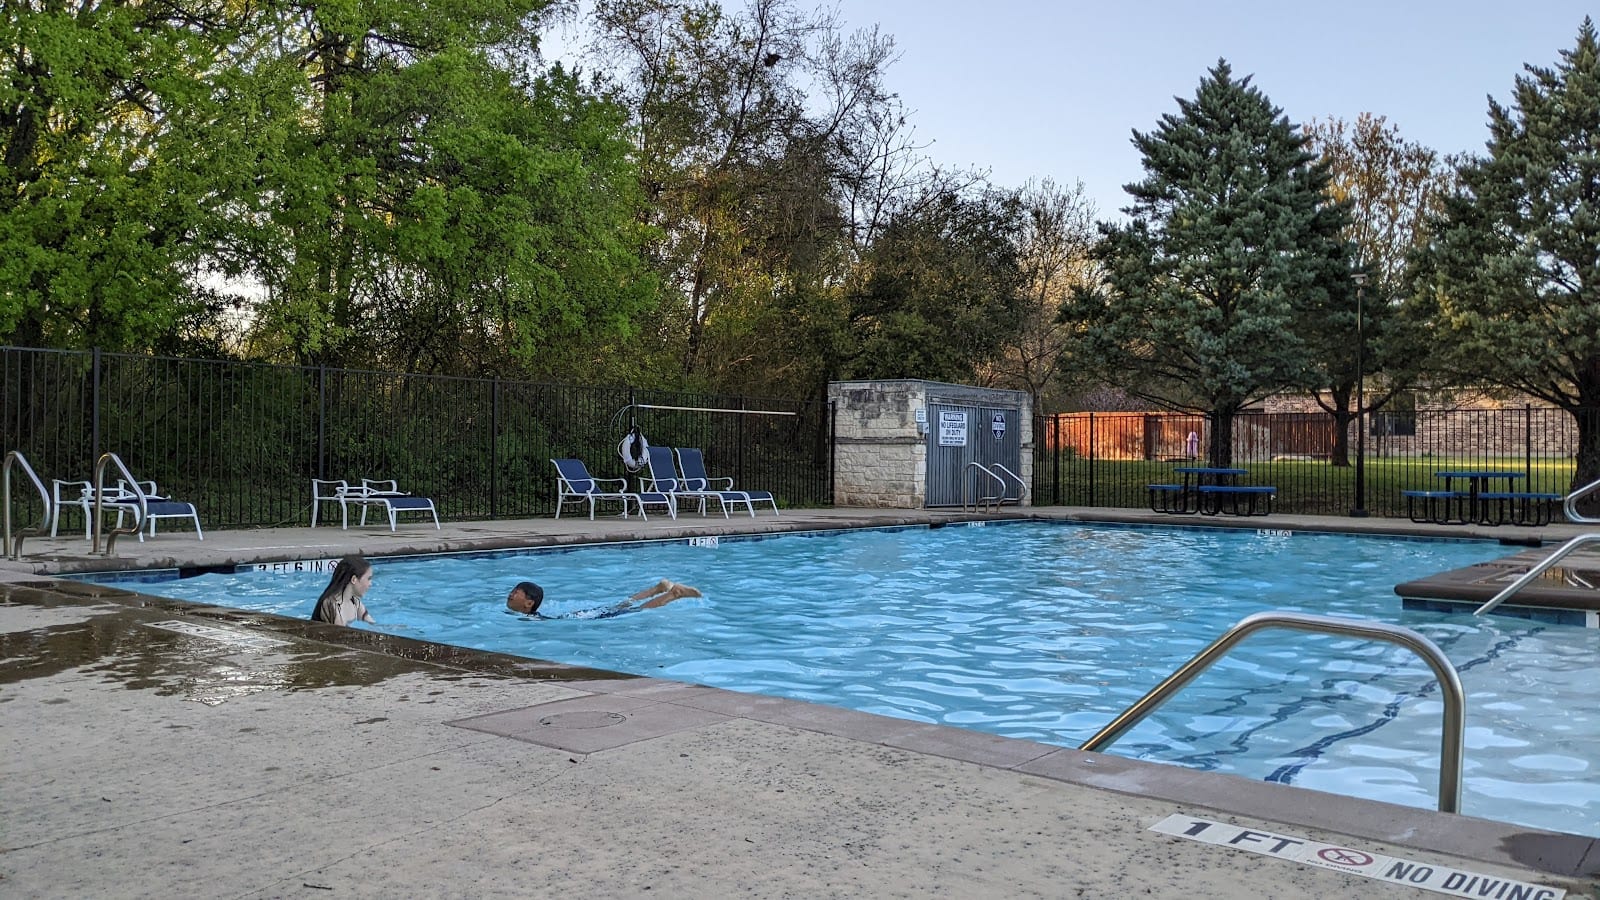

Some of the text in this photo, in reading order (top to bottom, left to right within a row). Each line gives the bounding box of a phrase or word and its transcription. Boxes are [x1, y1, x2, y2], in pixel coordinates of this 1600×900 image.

[274, 562, 288, 574] FT
[311, 561, 323, 573] IN
[1183, 821, 1304, 854] 1 FT
[1385, 861, 1555, 900] NO DIVING
